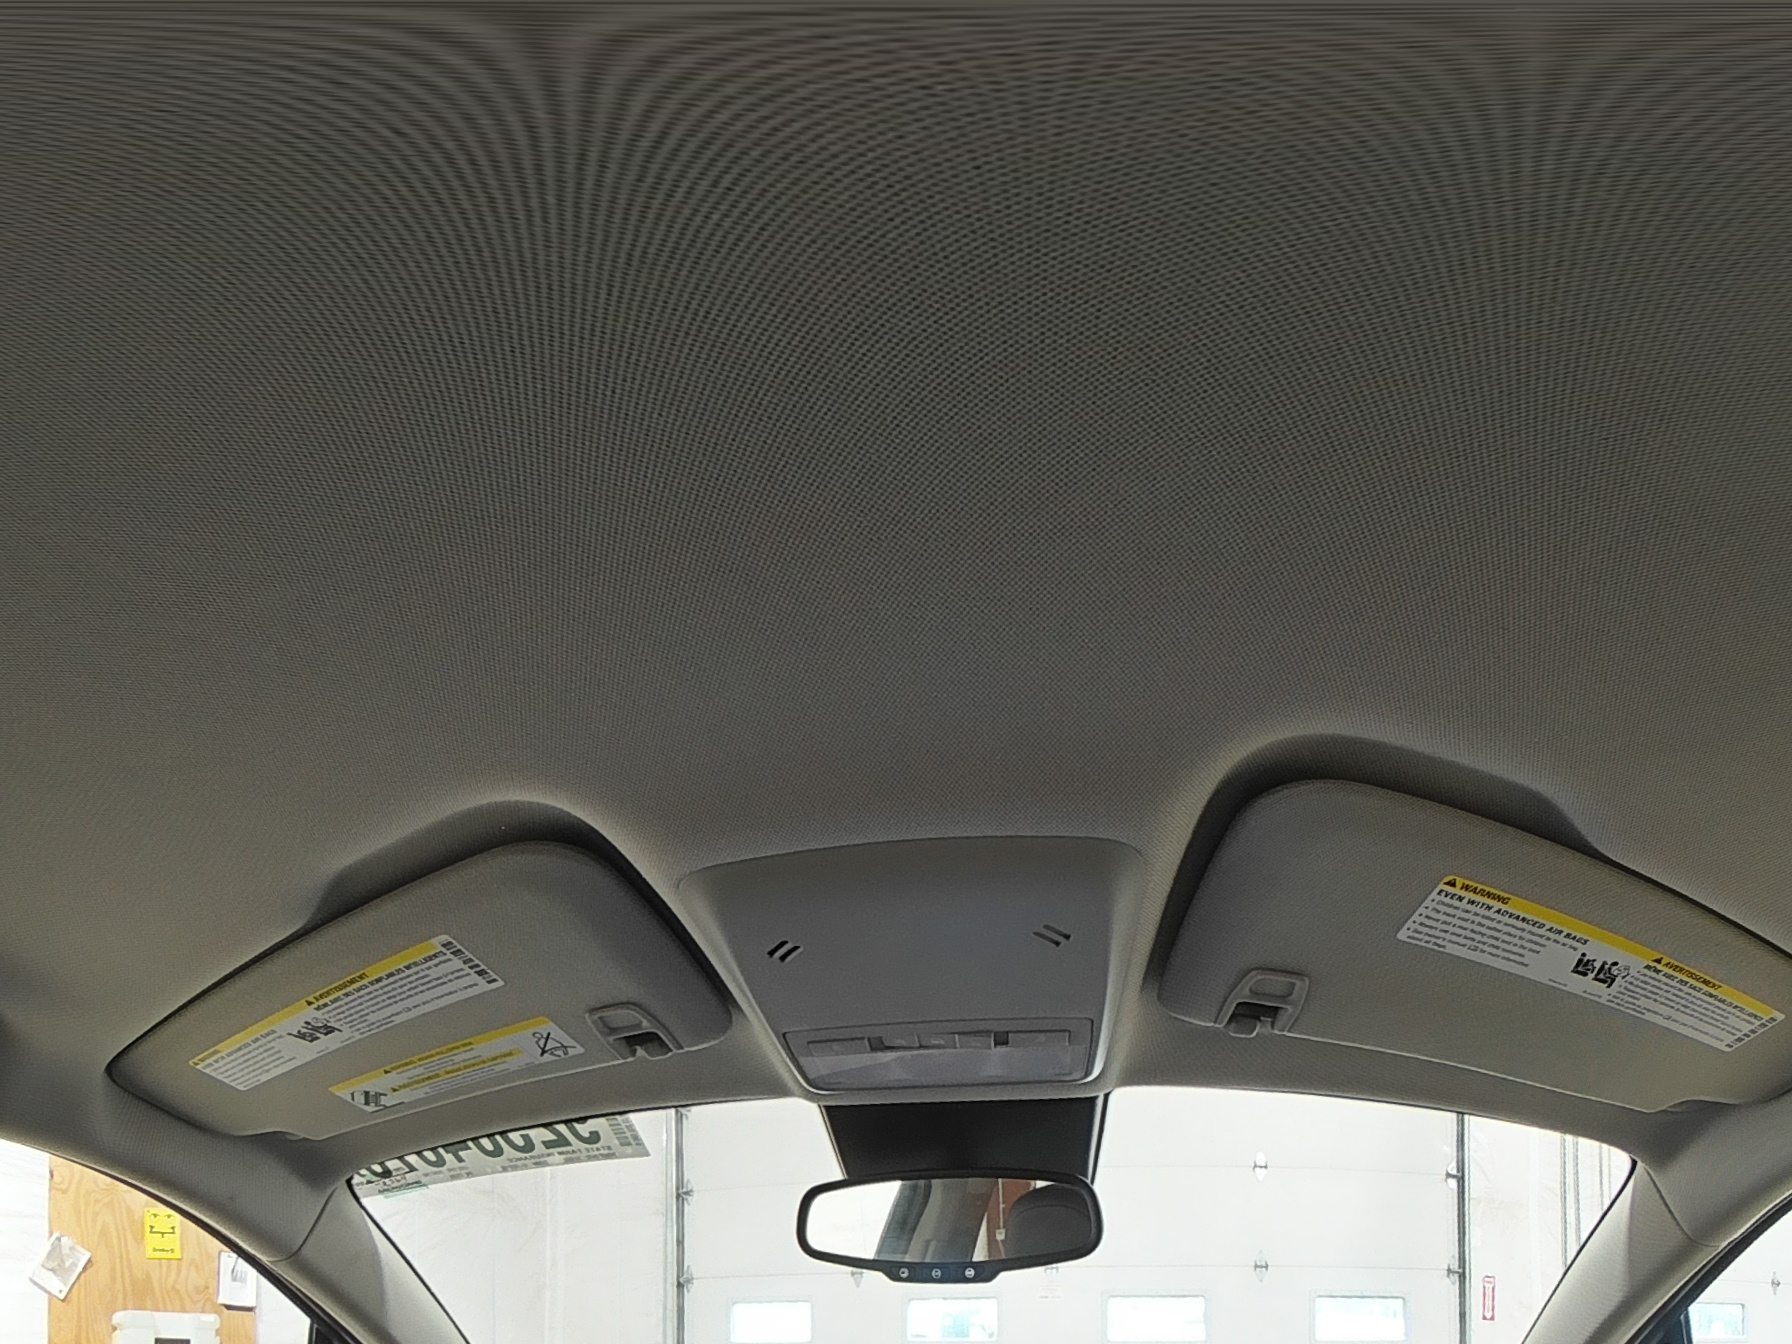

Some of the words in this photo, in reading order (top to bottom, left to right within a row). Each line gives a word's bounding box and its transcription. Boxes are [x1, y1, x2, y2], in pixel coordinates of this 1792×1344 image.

[1459, 882, 1511, 905] WARNING
[1436, 888, 1464, 903] EVEN
[1467, 897, 1493, 913] WITH
[1493, 908, 1546, 929] ADVANCED
[1545, 926, 1564, 936] AIR
[1563, 932, 1589, 946] BAGS
